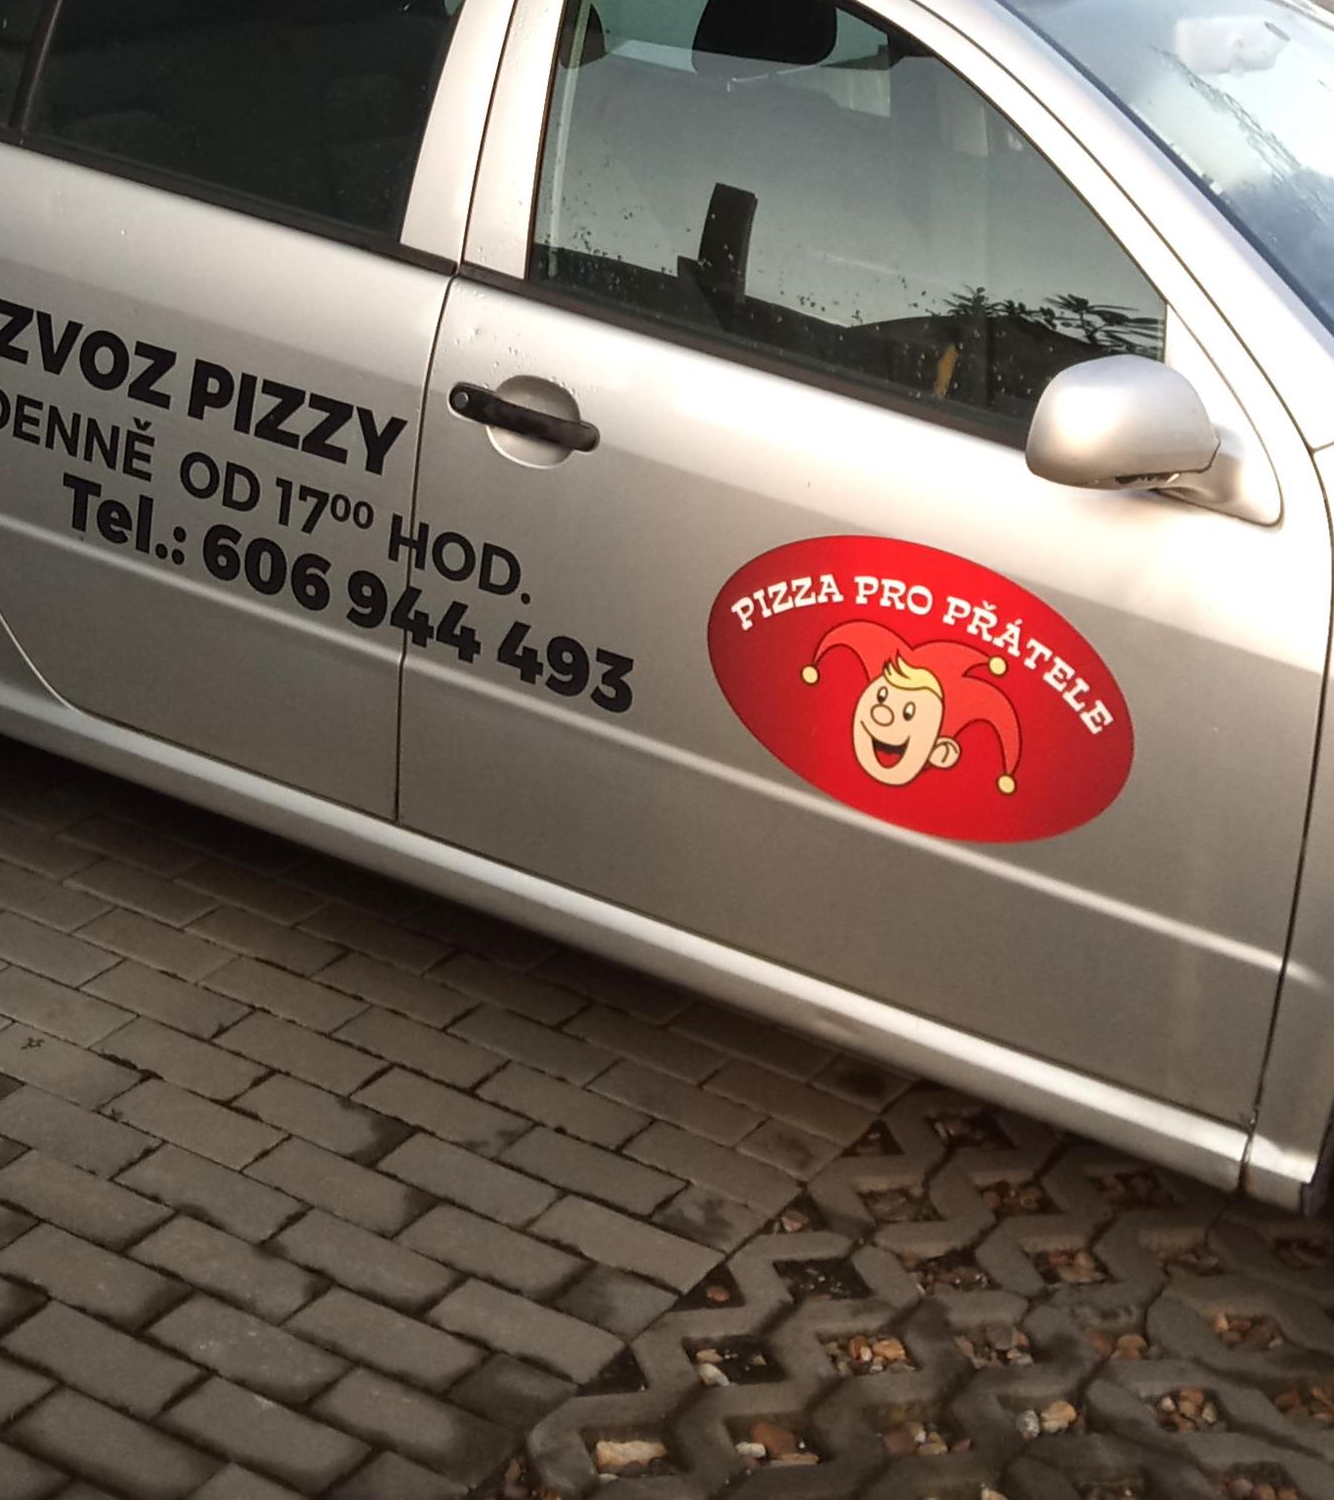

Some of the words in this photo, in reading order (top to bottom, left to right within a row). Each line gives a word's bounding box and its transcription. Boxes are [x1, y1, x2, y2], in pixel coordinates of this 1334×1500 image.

[187, 359, 407, 475] PIZZY
[62, 473, 185, 564] Tel.:
[203, 525, 331, 611] 606
[347, 570, 480, 662] 944
[497, 621, 634, 712] 493
[180, 452, 261, 512] OD
[388, 514, 531, 603] HOD.
[731, 574, 844, 630] PIZZA
[854, 575, 933, 615] PRO
[942, 596, 1114, 734] PŘÁTELE
